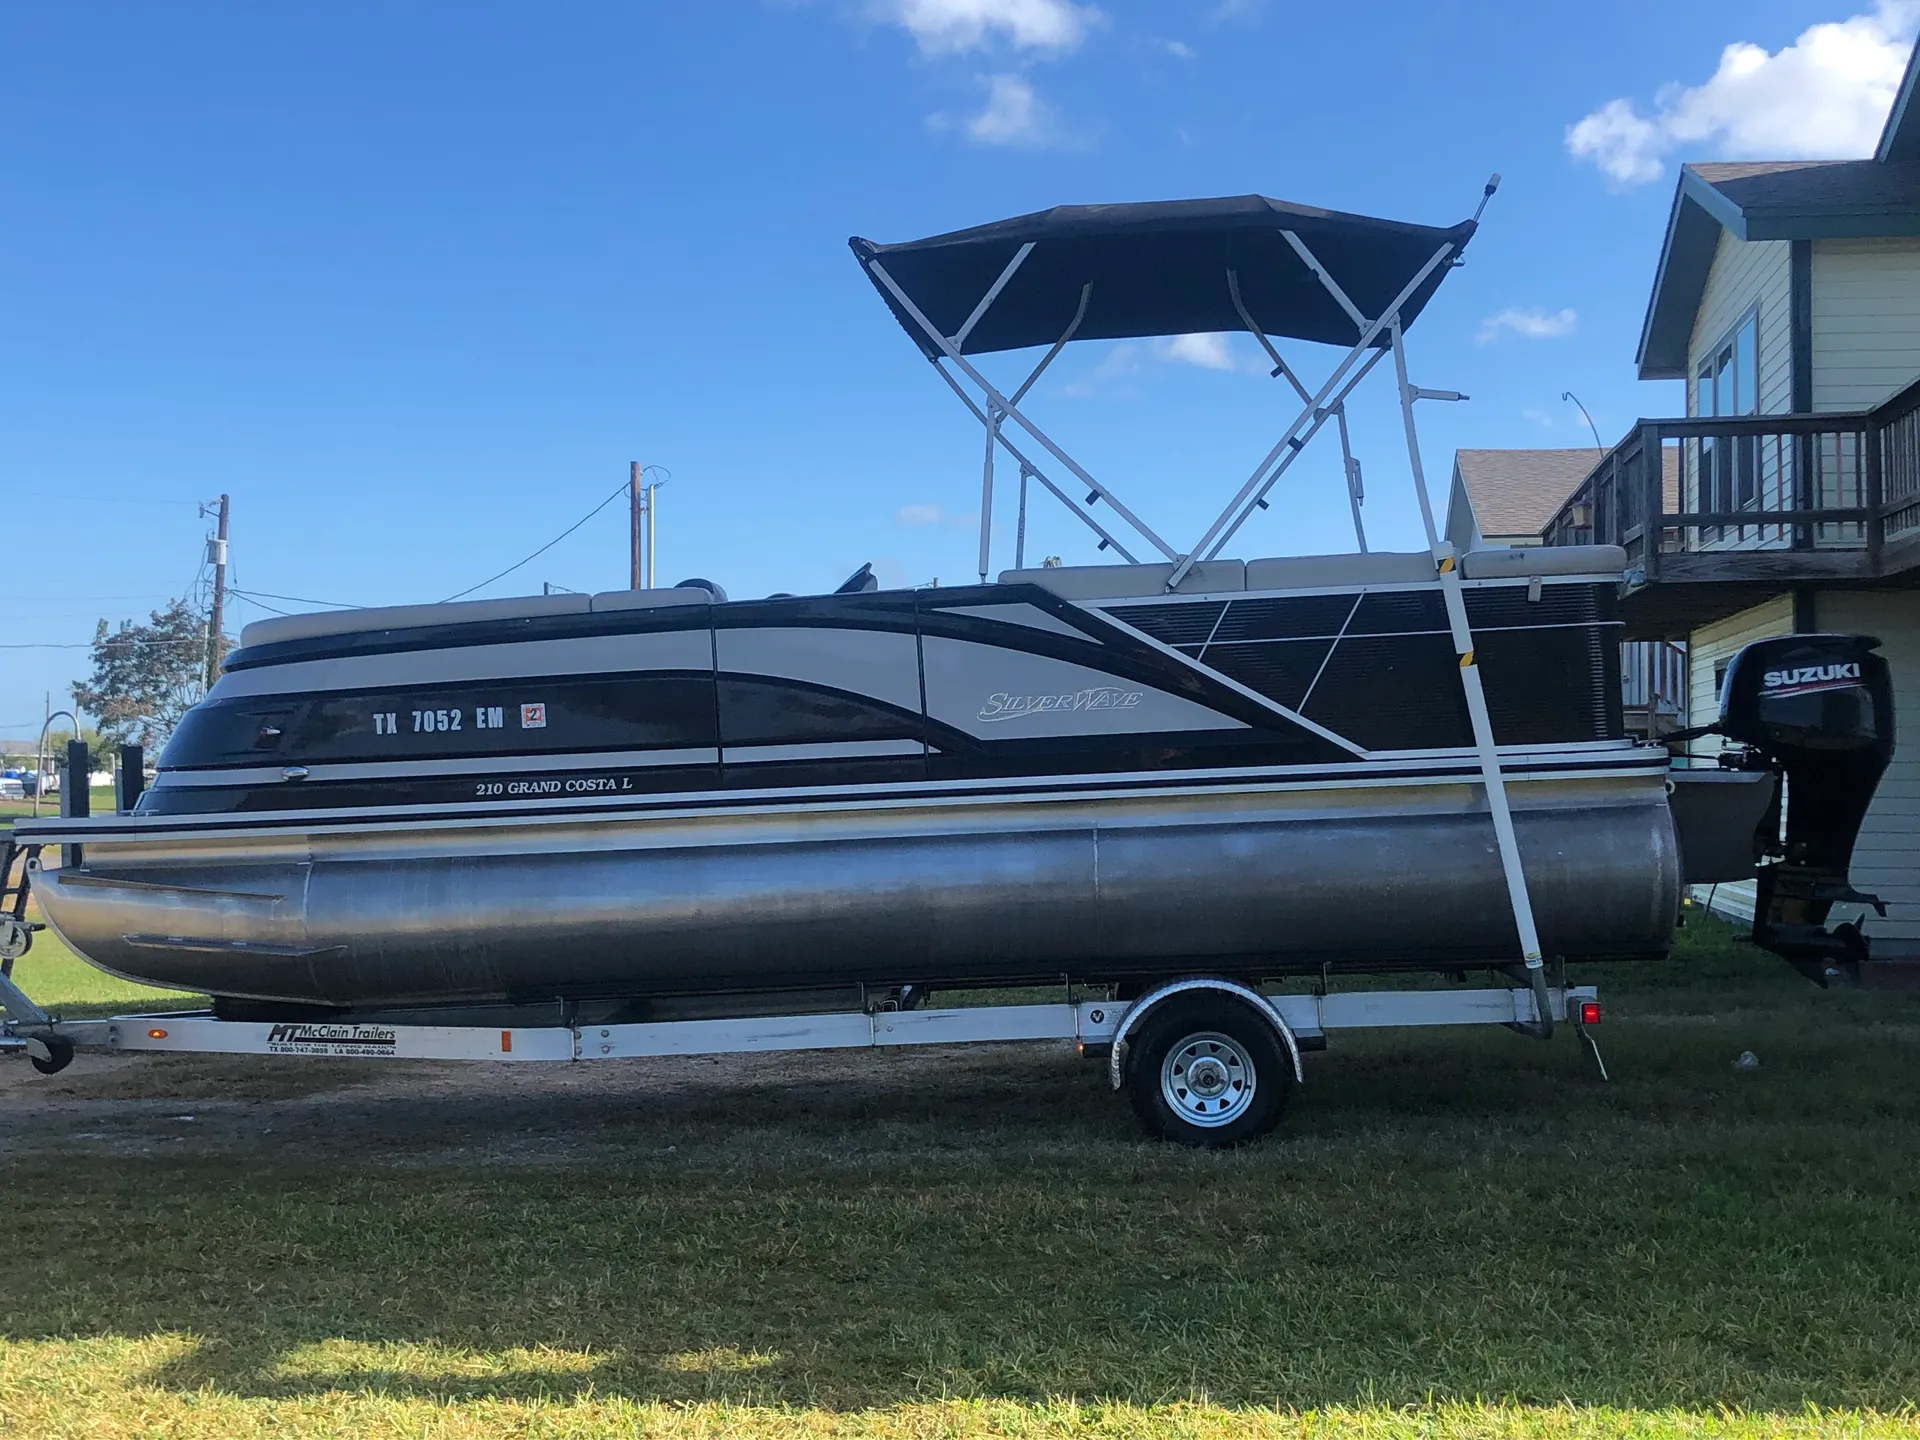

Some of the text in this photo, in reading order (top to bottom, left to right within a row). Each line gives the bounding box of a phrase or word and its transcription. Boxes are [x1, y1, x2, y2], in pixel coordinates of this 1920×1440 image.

[1763, 662, 1861, 687] SUZUKI
[373, 707, 504, 735] TX 7052 EM
[476, 777, 633, 796] 210 GRAND COSTA L
[300, 1025, 349, 1039] McClain
[352, 1026, 396, 1040] Trailers
